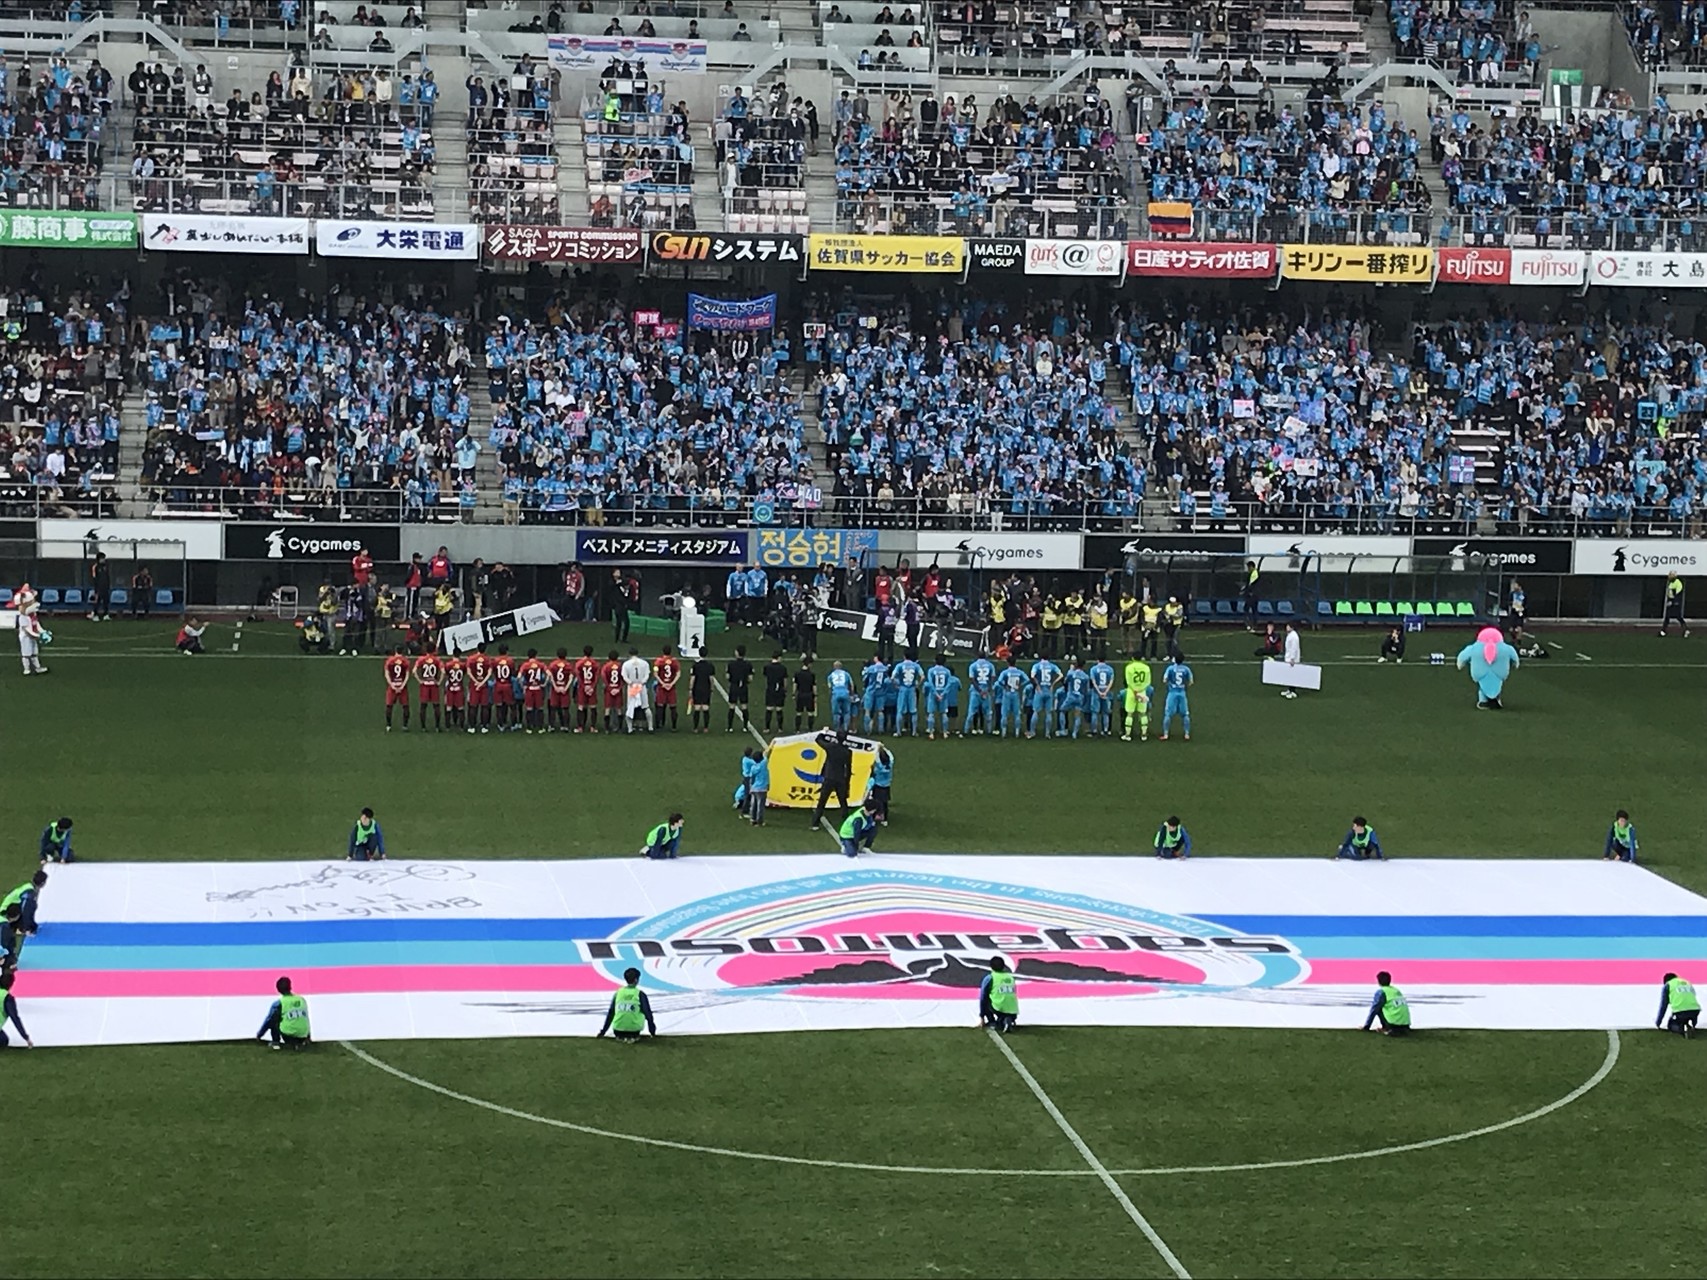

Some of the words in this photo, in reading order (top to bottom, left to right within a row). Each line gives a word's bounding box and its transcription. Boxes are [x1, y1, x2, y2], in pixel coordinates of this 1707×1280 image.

[376, 229, 464, 250] 大栄電通
[508, 228, 542, 239] SAGA
[547, 231, 579, 240] SPORTS
[712, 239, 799, 261] システム
[974, 244, 1022, 257] MAEDA
[817, 248, 956, 267] 佐賀県サッカー協会
[980, 258, 1015, 268] GROUP
[1134, 249, 1270, 269] 日産サティオ佐賀
[1288, 252, 1428, 274] キリン一番搾り
[1446, 251, 1504, 280] FUJITSU
[1521, 253, 1578, 280] FUJITSU
[288, 537, 361, 554] Cygames
[583, 538, 741, 555] ベストアメニティスタジアム
[976, 546, 1044, 561] Cygames
[1631, 553, 1697, 568] Cygames
[394, 665, 402, 678] 9
[422, 664, 437, 677] 20
[449, 669, 464, 682] 30
[476, 663, 484, 676] 5
[496, 665, 510, 679] 10
[557, 668, 565, 681] 6
[582, 667, 594, 680] 16
[635, 667, 640, 680] 1
[664, 665, 672, 678] 3
[1040, 669, 1052, 682] 15
[610, 670, 619, 683] 8
[935, 674, 946, 688] 13
[1099, 672, 1107, 685] 9
[1133, 671, 1146, 684] 20
[1175, 672, 1183, 685] 5
